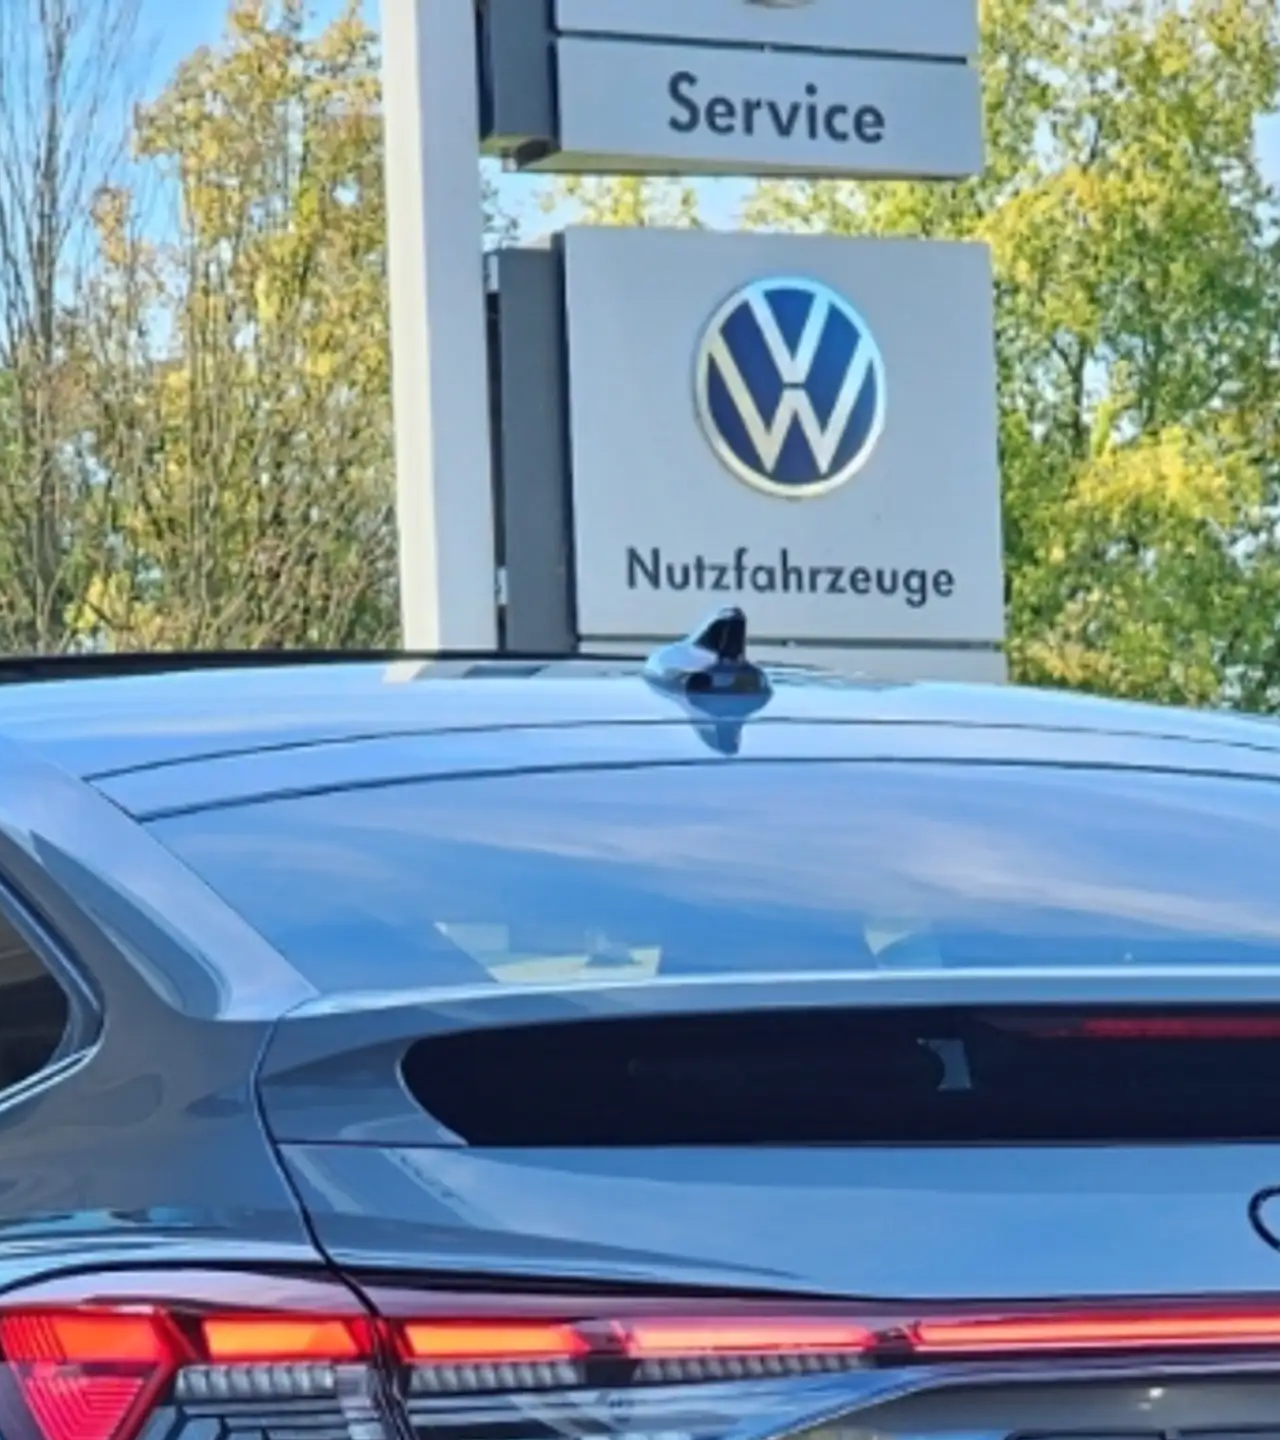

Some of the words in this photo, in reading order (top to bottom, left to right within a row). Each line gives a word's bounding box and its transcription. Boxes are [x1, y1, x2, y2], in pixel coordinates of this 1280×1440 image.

[667, 70, 886, 145] Service
[696, 276, 887, 498] VW
[626, 545, 955, 608] Nutzfahrzeuge
